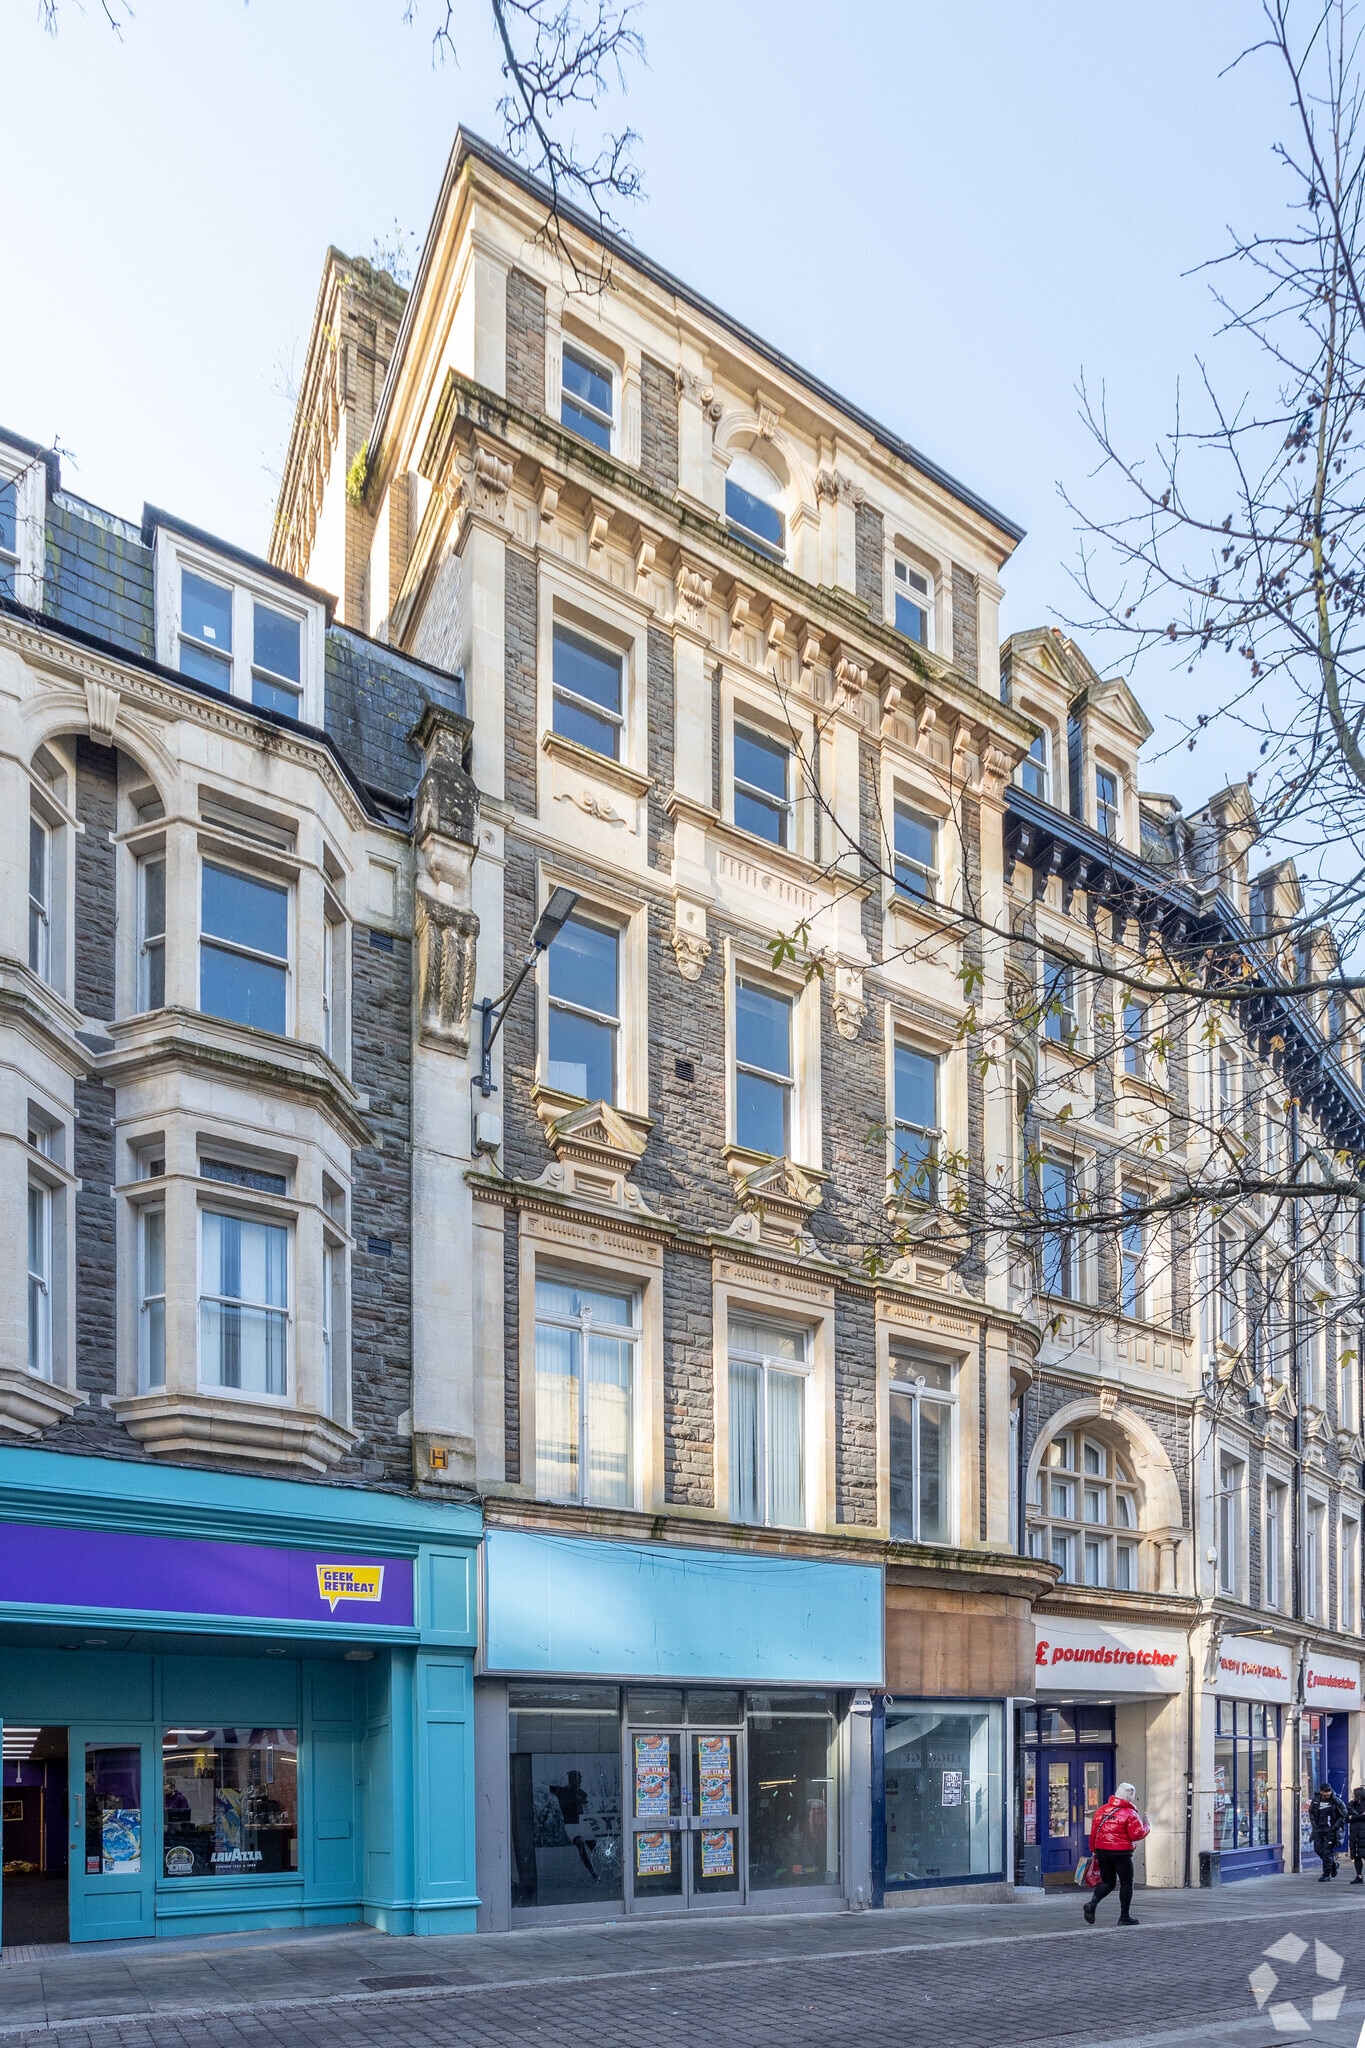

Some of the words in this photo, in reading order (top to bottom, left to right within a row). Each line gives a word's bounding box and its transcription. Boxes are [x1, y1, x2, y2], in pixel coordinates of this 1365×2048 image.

[432, 1449, 446, 1467] H
[324, 1571, 353, 1582] GEEK
[324, 1581, 375, 1592] RETREAT
[1052, 1646, 1178, 1667] poundstretcher
[1313, 1674, 1356, 1690] poundstretcher
[210, 1848, 263, 1863] LAVAZZA
